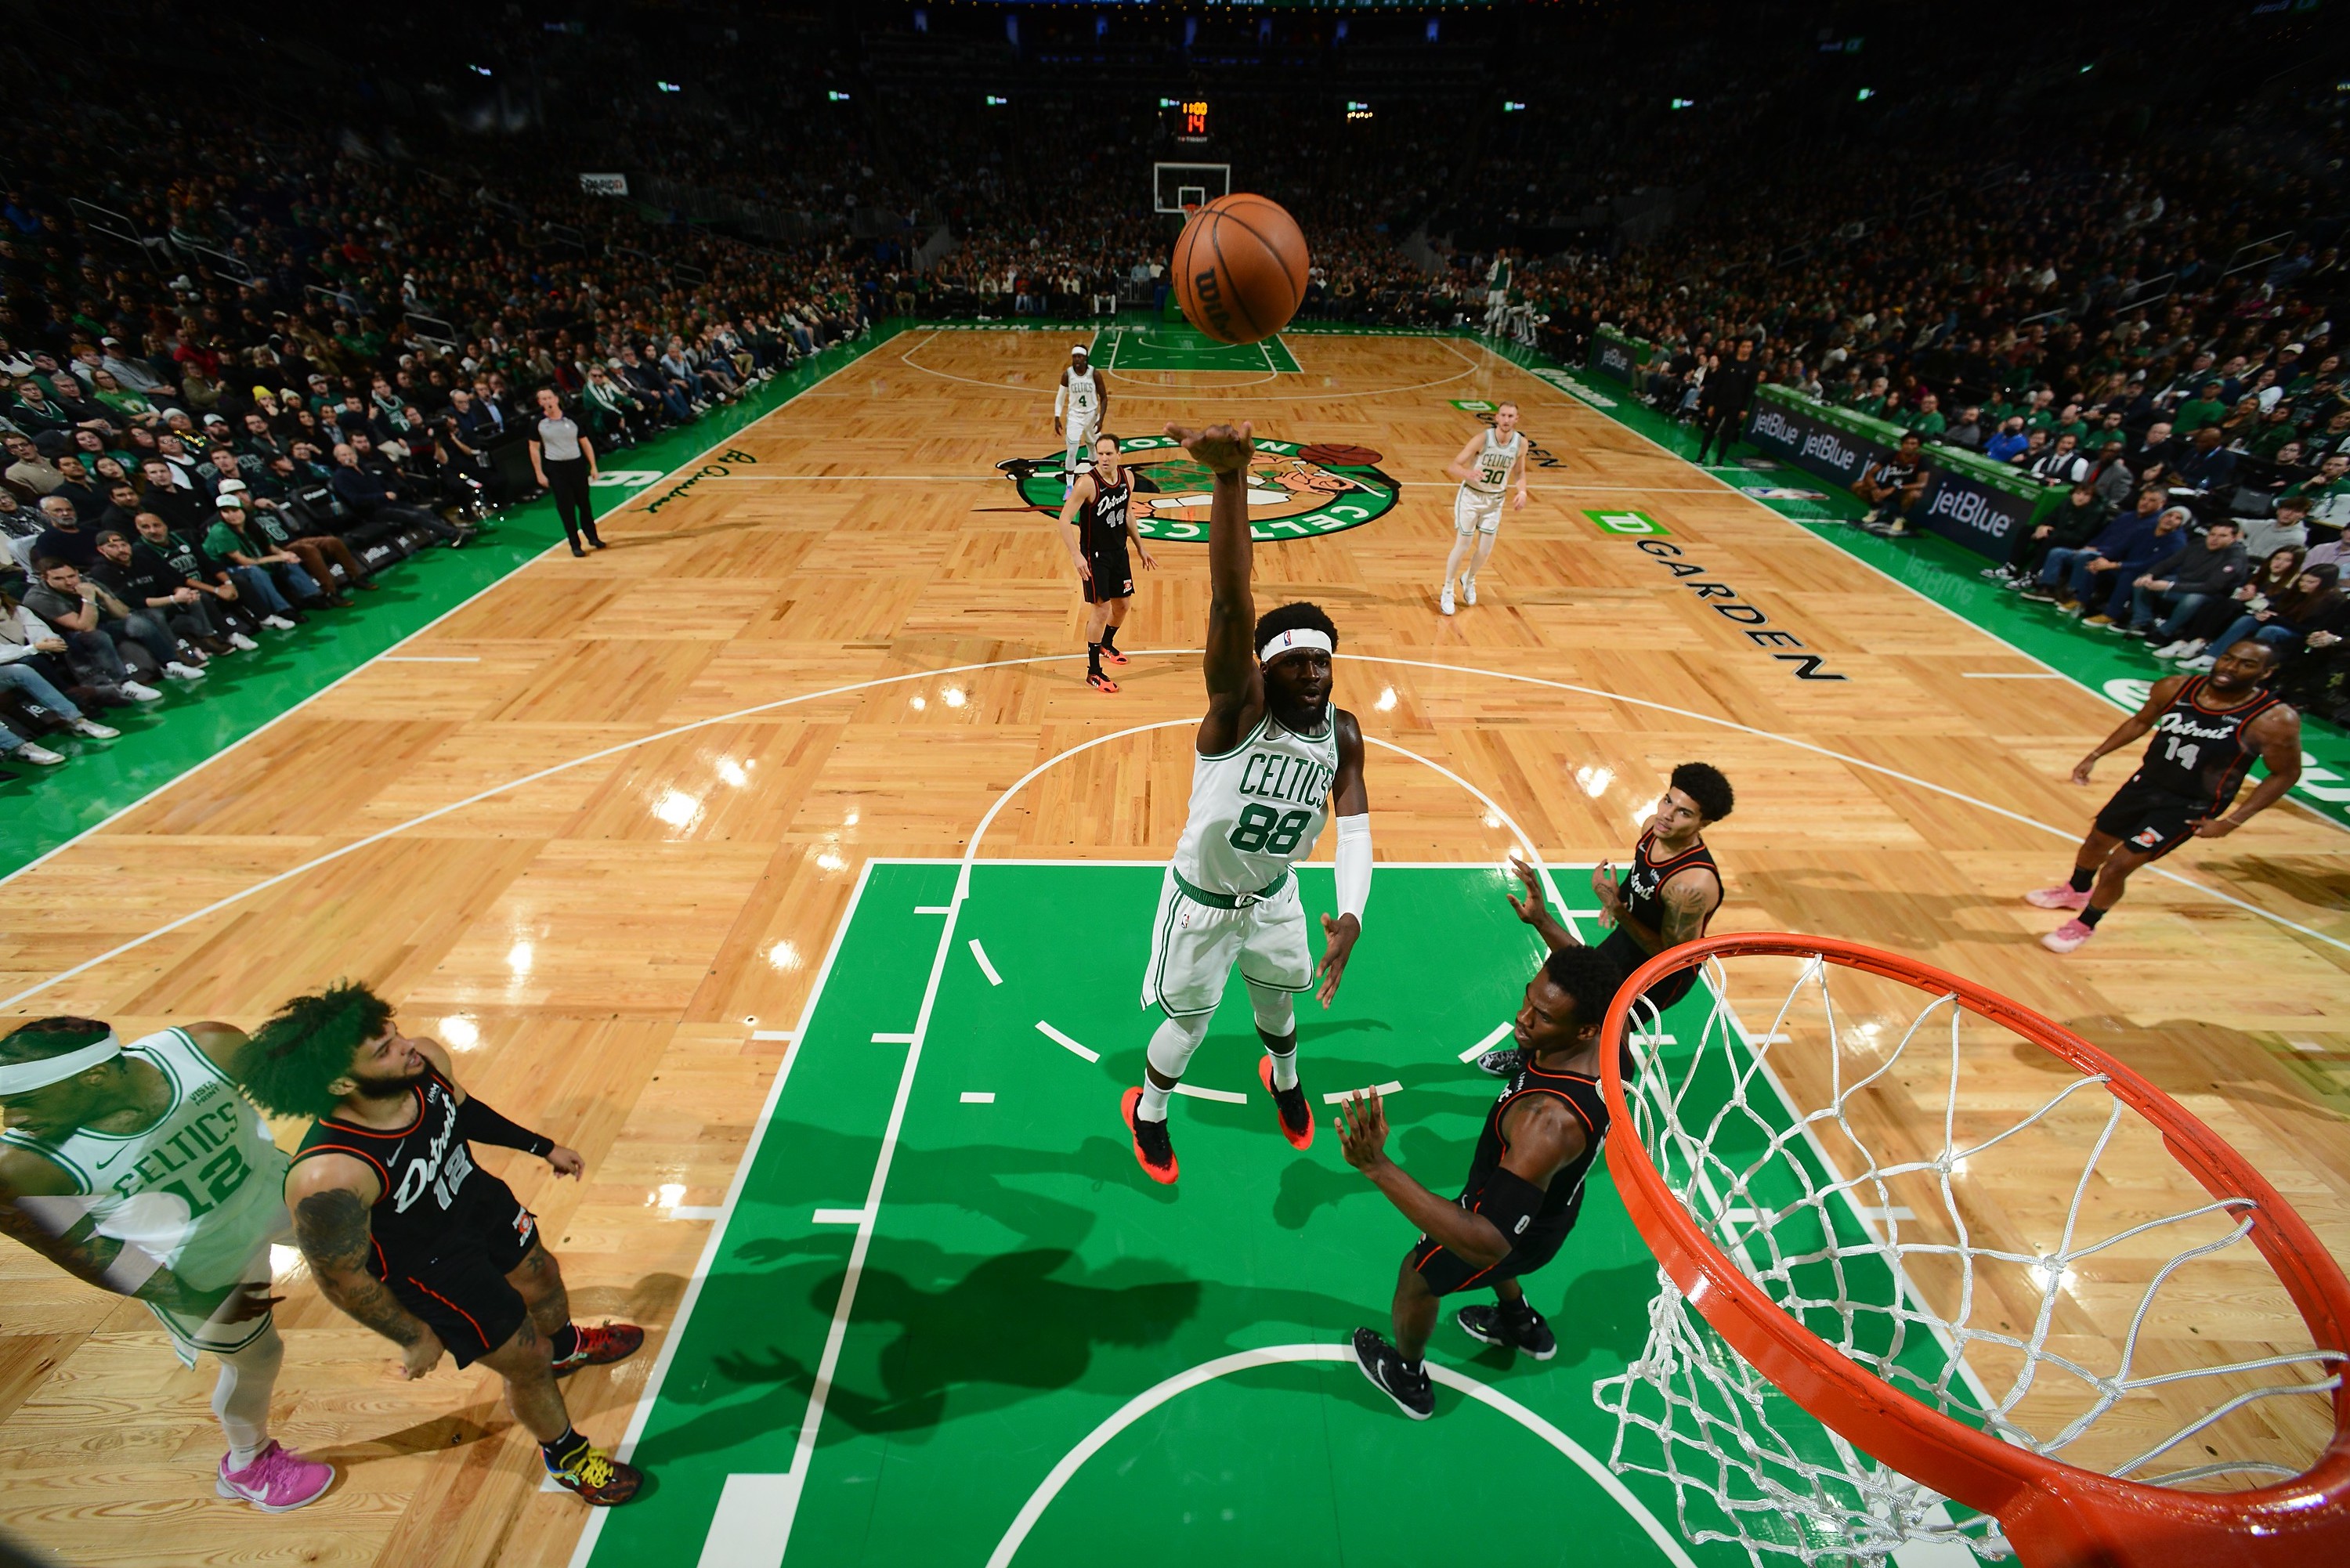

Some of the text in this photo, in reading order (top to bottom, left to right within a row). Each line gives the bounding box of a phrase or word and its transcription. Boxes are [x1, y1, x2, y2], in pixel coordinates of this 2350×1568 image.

[1188, 115, 1204, 132] 14
[1071, 382, 1094, 393] CELTICS
[1079, 395, 1087, 406] 4
[1482, 454, 1514, 469] CELTICS
[1752, 407, 1799, 446] jetBlue
[1800, 428, 1856, 471] jetBlue
[1928, 482, 2011, 538] jetBlue
[1480, 469, 1506, 485] 30
[1097, 488, 1129, 517] Detroit
[1106, 509, 1125, 528] 44
[1635, 539, 1851, 681] GARDEN
[2161, 713, 2235, 739] Detroit
[2164, 736, 2200, 770] 14
[1239, 753, 1333, 808] CELTICS
[1230, 803, 1312, 854] 88
[190, 1081, 217, 1101] VISTA
[196, 1087, 221, 1107] PRINT
[427, 1083, 440, 1104] UWM
[112, 1102, 238, 1200] CELTICS
[393, 1093, 457, 1214] Detroit
[161, 1145, 252, 1221] 12
[433, 1143, 473, 1211] 12
